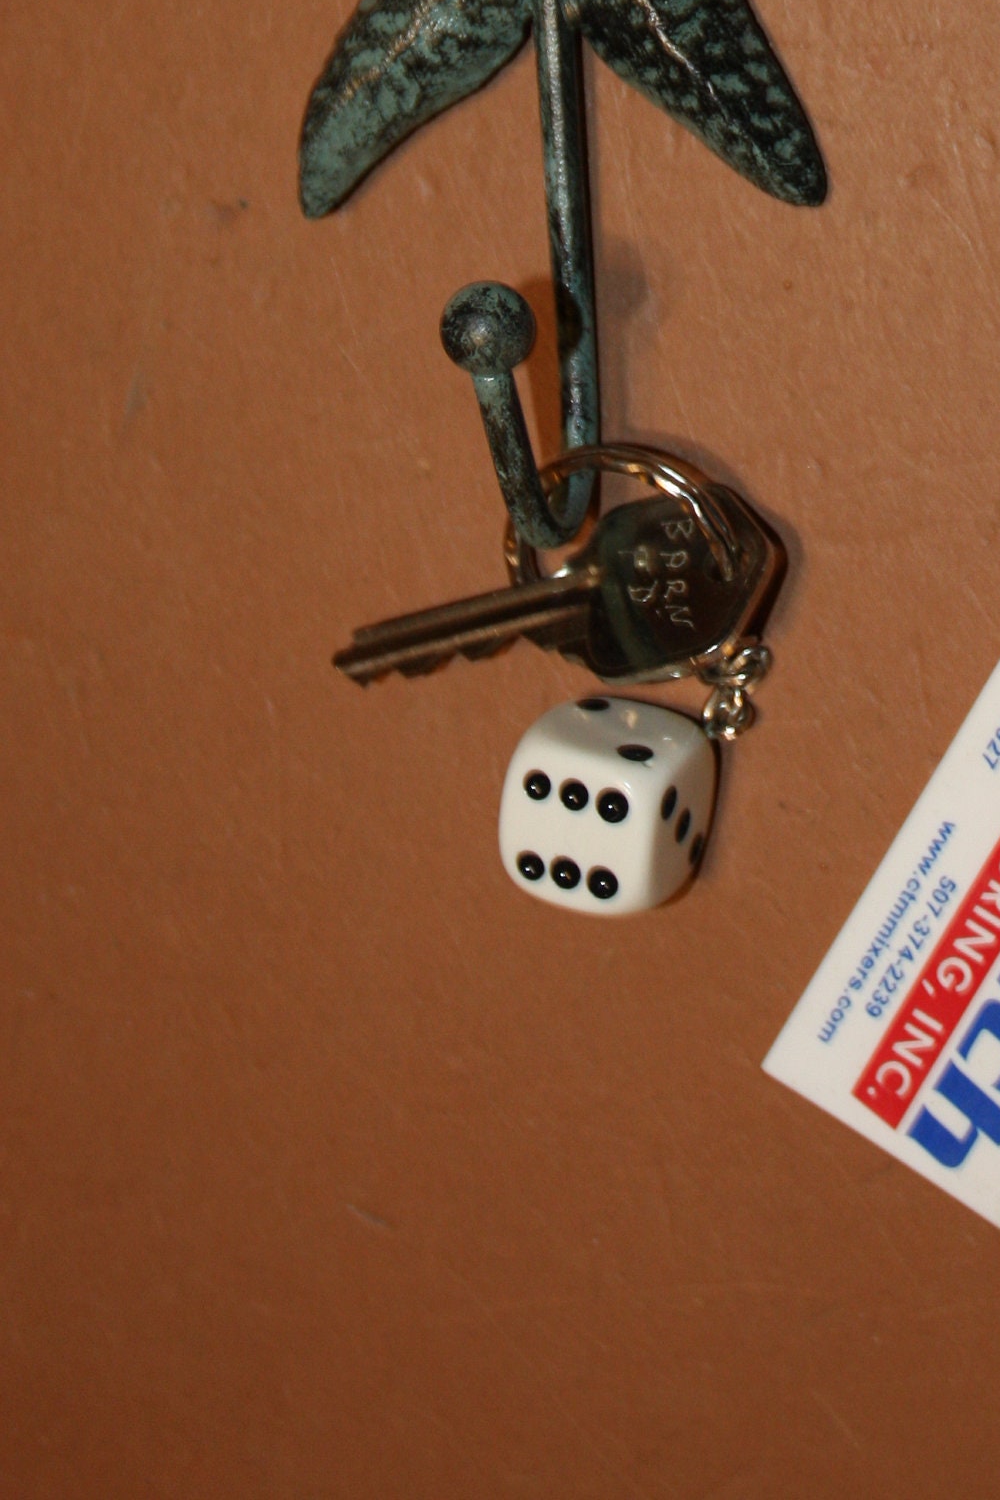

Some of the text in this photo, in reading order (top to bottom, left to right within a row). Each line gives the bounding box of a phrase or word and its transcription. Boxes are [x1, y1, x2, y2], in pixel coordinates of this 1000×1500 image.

[819, 822, 955, 1043] www.ctmmixers.com
[867, 877, 957, 1019] 507-374-2239
[867, 1009, 944, 1097] INC.
